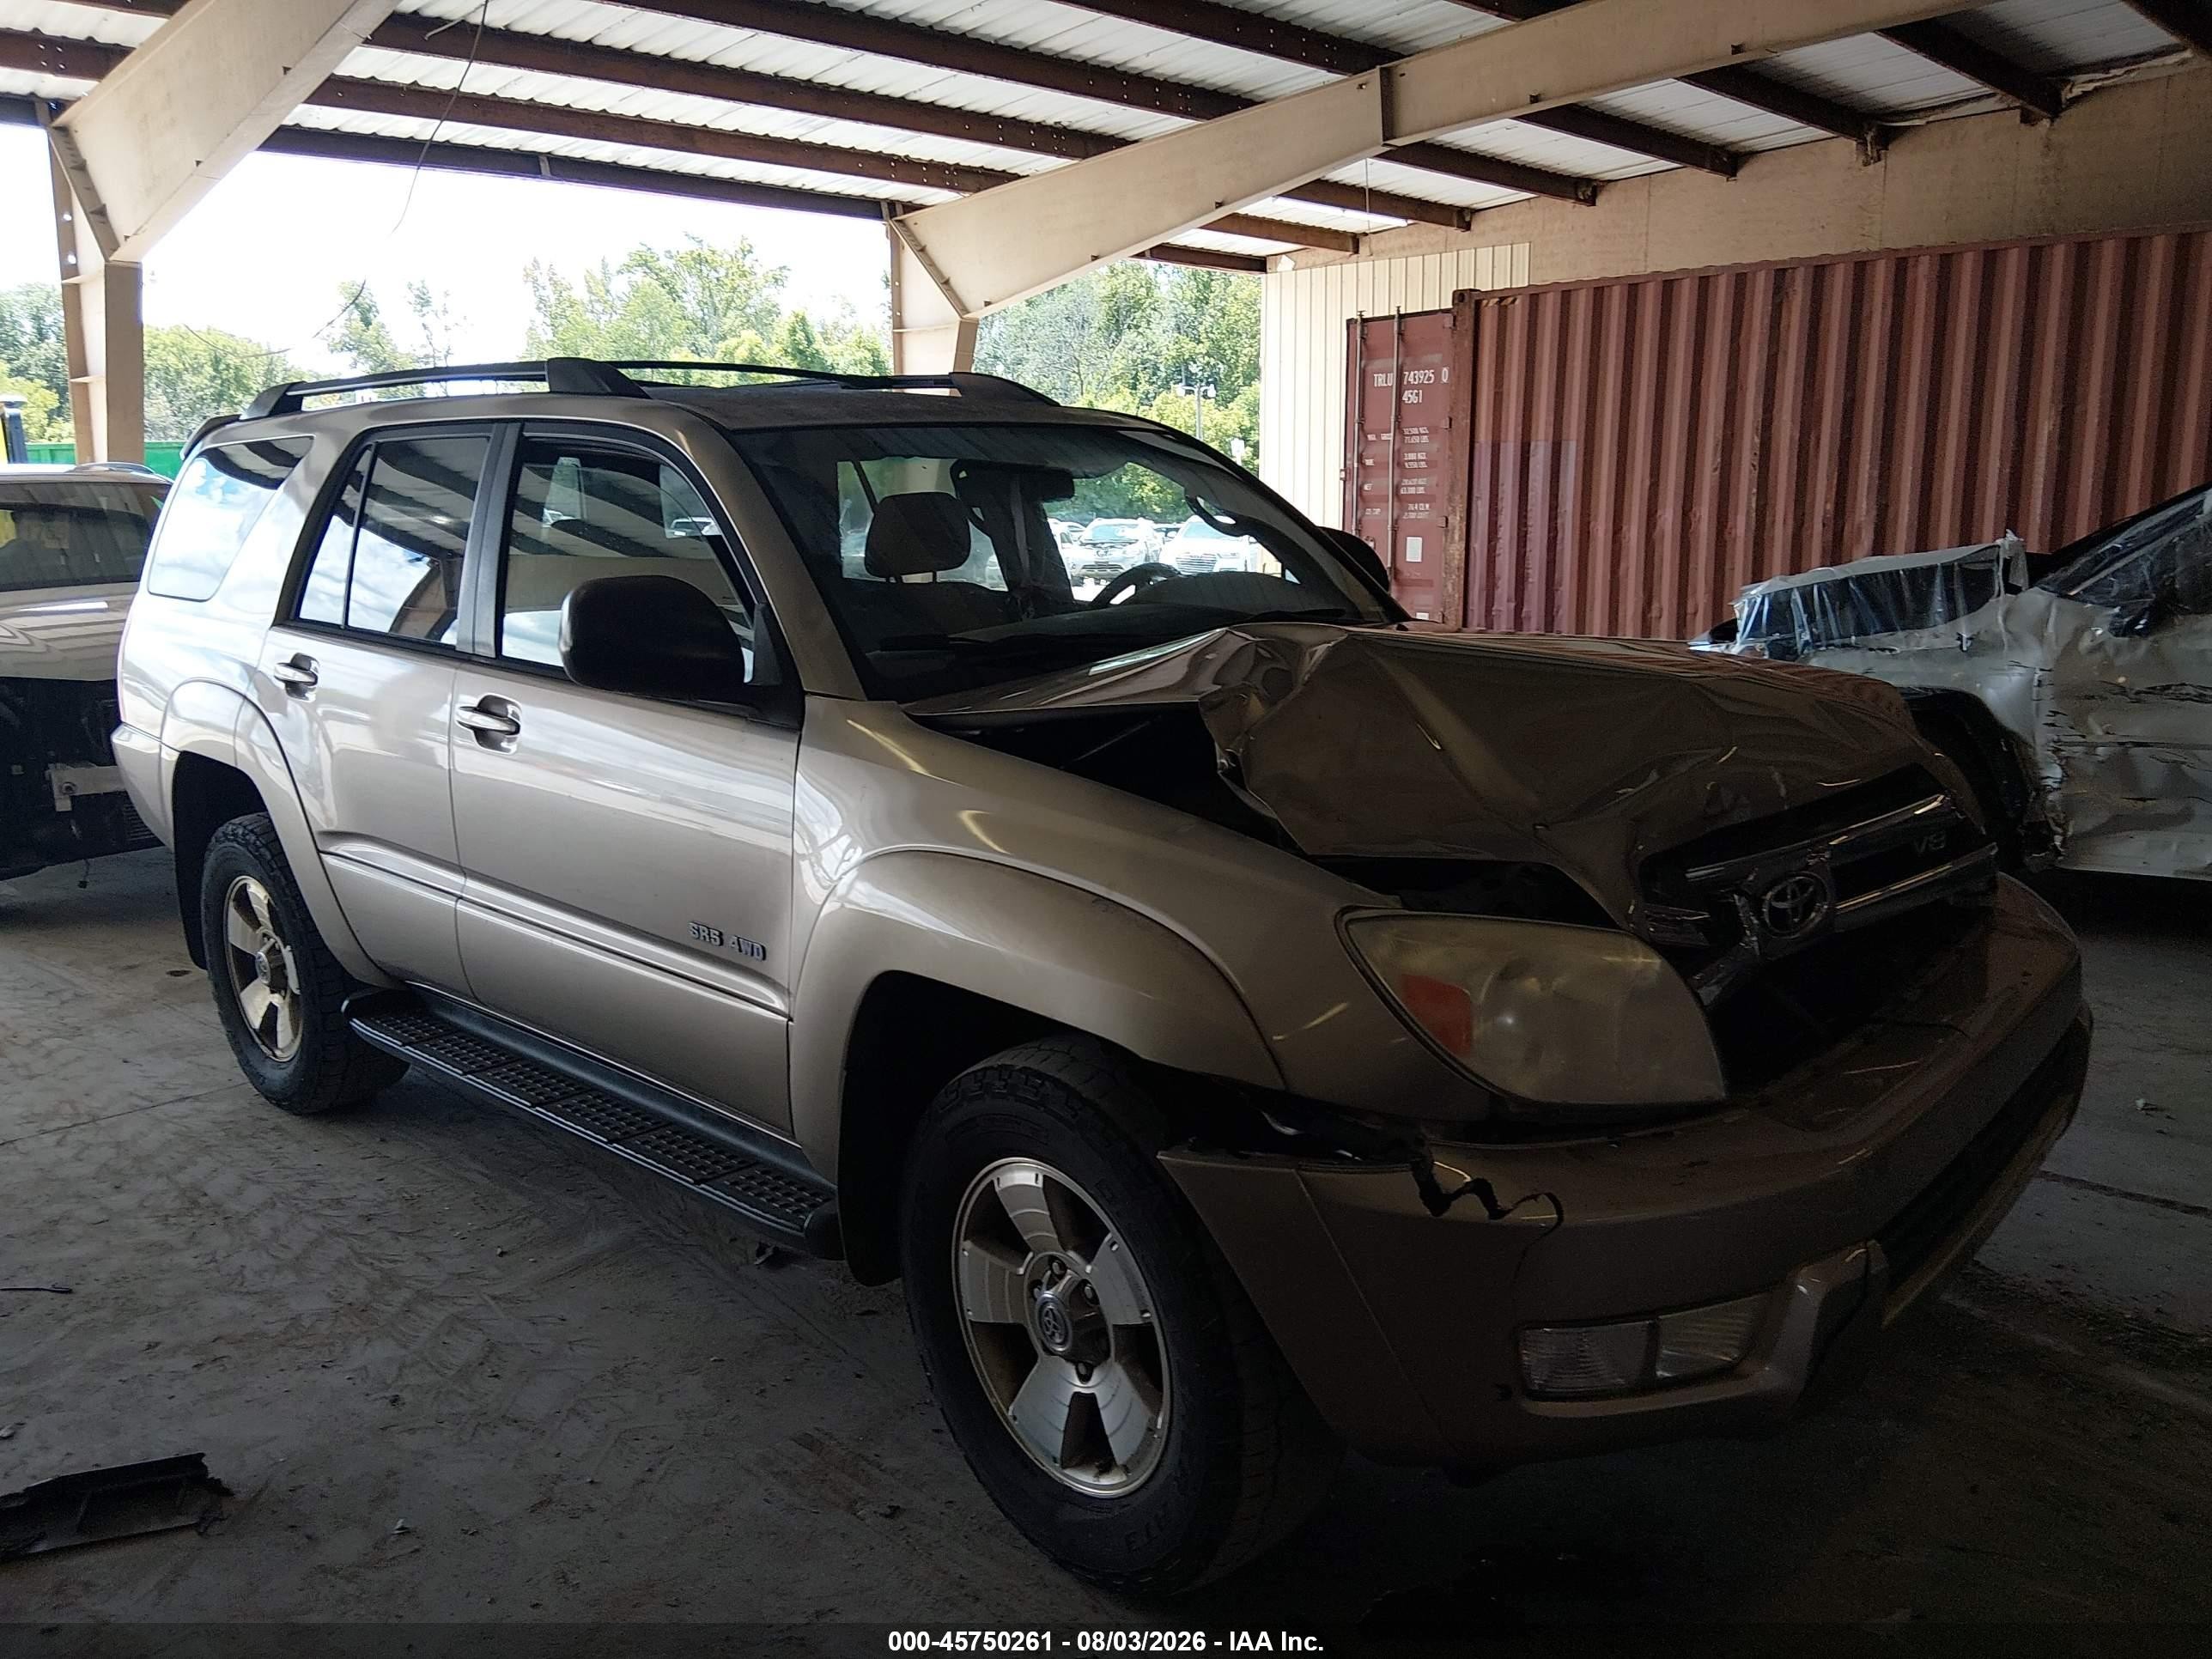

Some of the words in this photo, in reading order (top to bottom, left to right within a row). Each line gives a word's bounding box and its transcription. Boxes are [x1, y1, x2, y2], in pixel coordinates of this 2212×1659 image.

[1373, 373, 1394, 387] TRLU
[1403, 369, 1435, 385] 743925
[687, 921, 724, 946] SR5
[730, 935, 767, 961] 4WD
